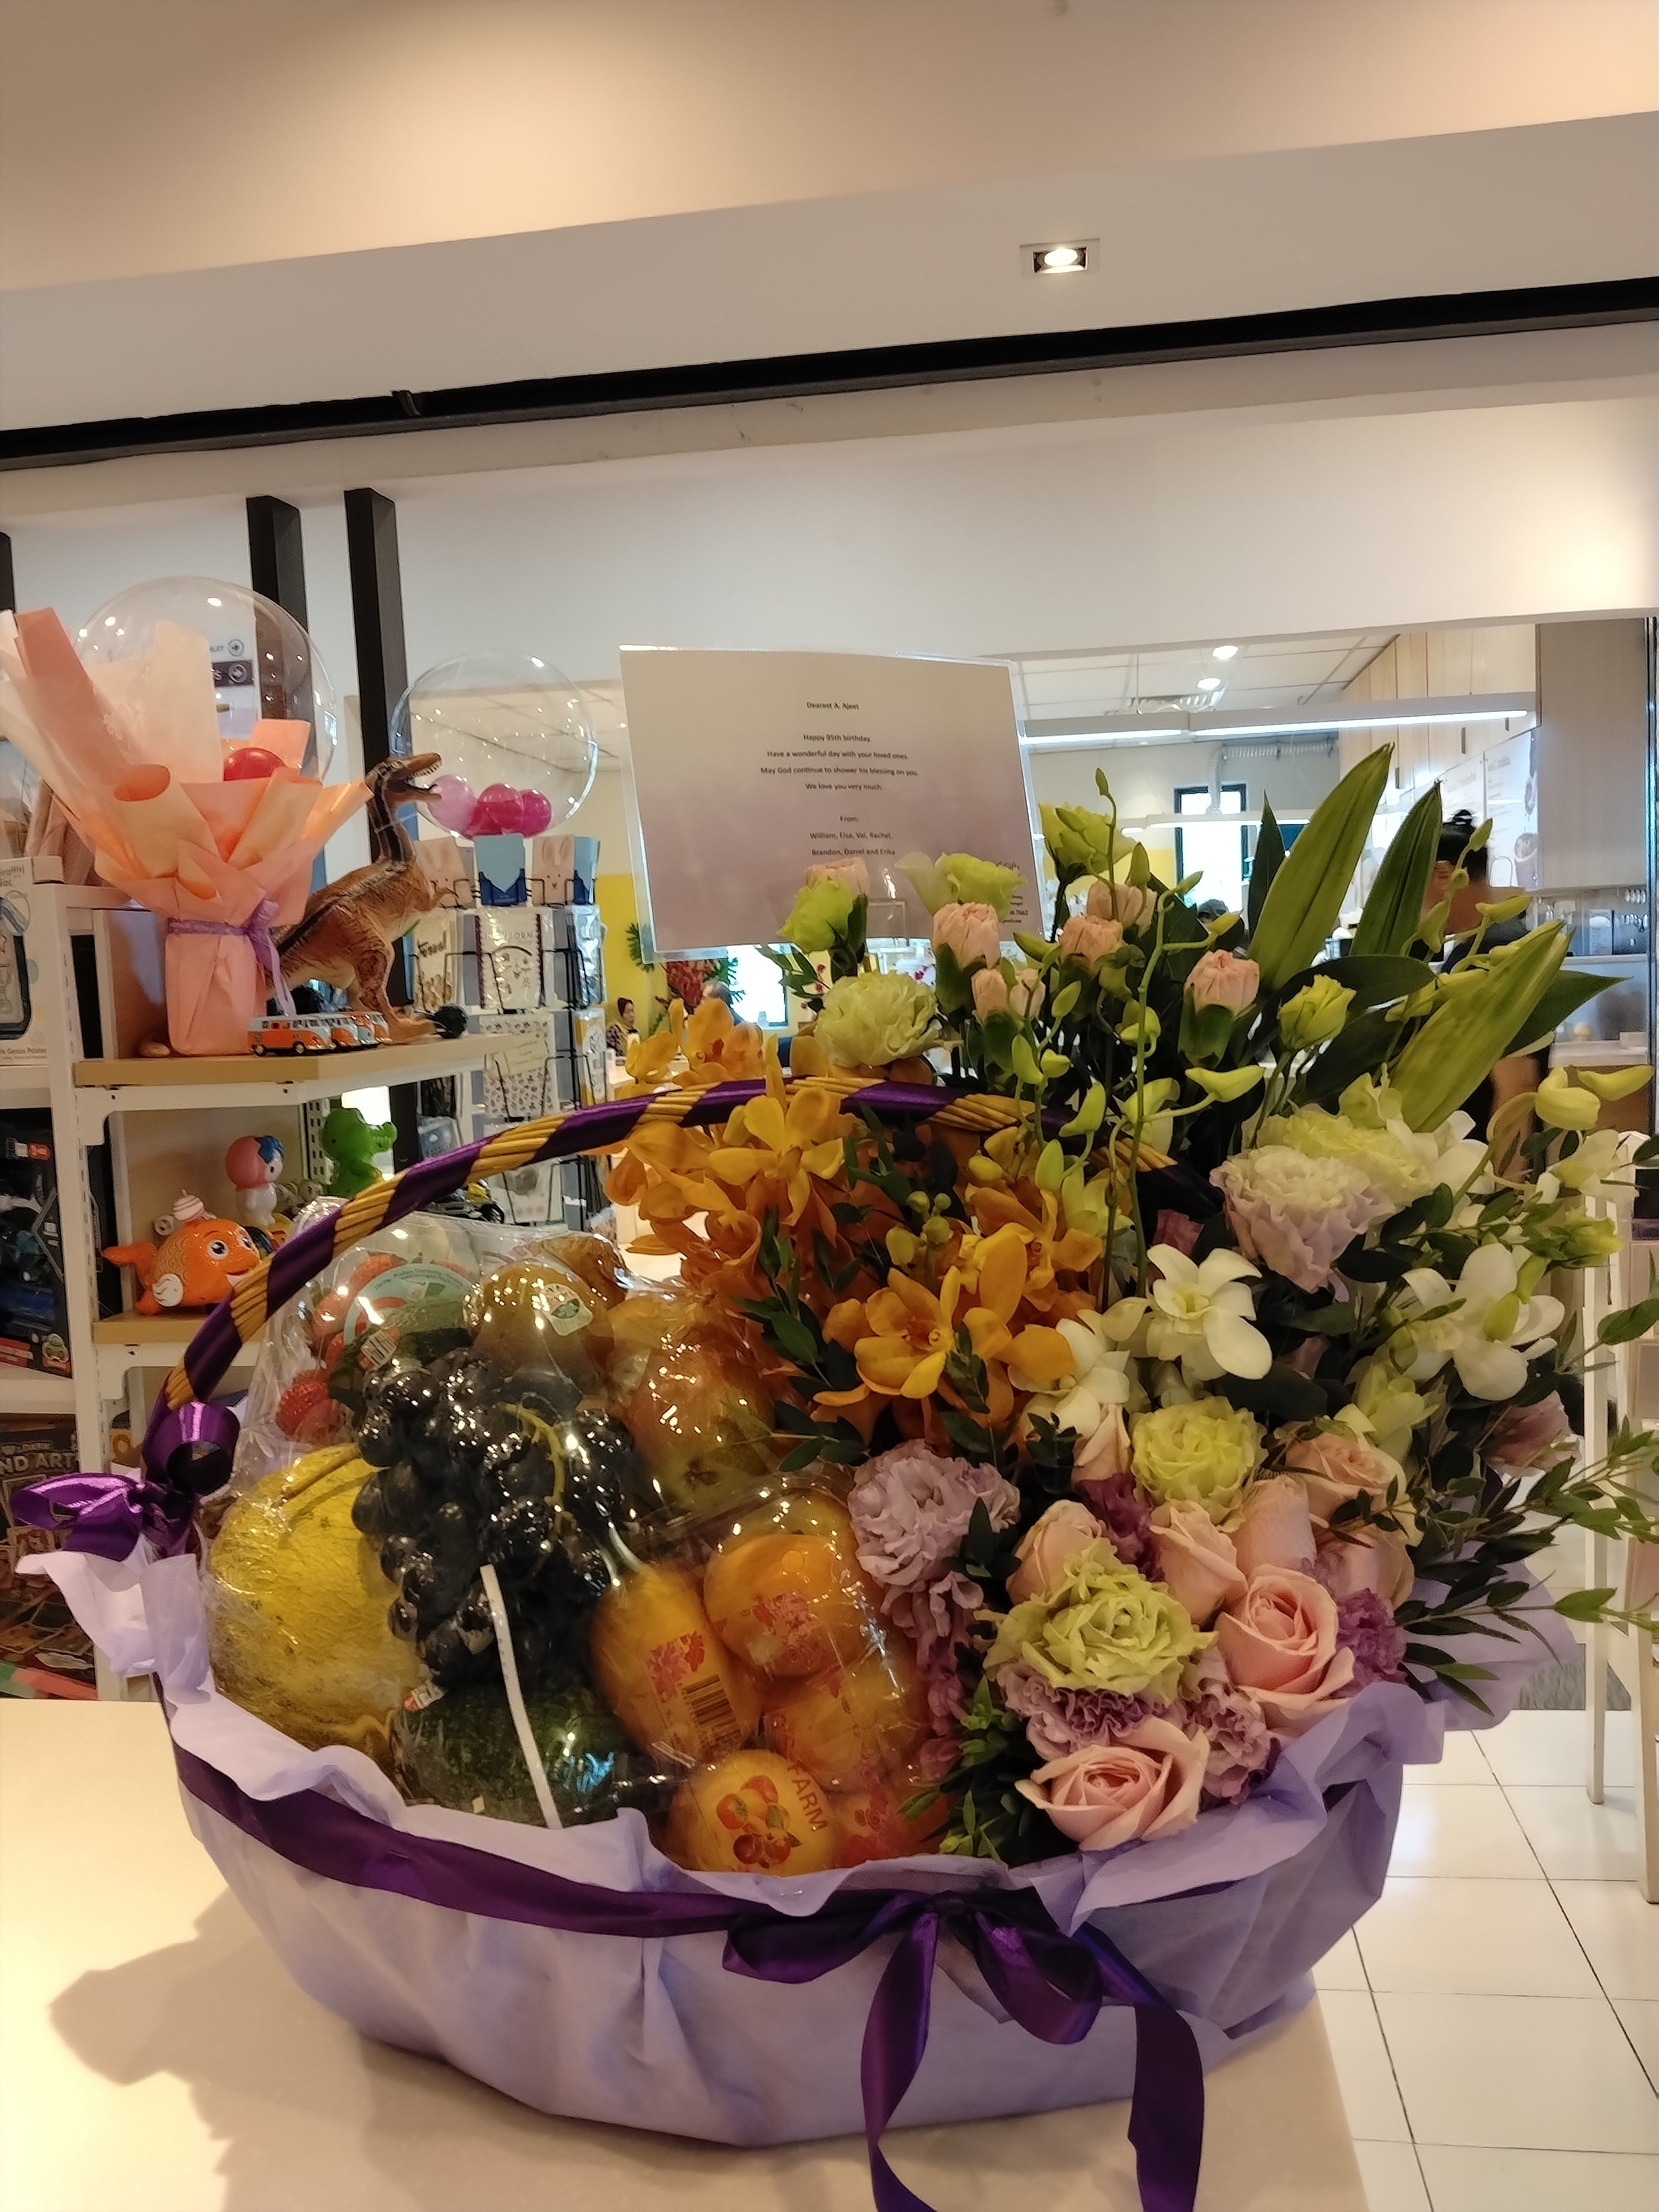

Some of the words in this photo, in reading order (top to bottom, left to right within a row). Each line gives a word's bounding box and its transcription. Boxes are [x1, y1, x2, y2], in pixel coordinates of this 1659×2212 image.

[843, 735, 871, 743] birthday.
[828, 750, 840, 758] day
[760, 767, 775, 775] May
[870, 767, 895, 776] blessing
[812, 848, 843, 856] Brandon,
[35, 1452, 76, 1469] ART
[786, 1762, 828, 1832] FARM
